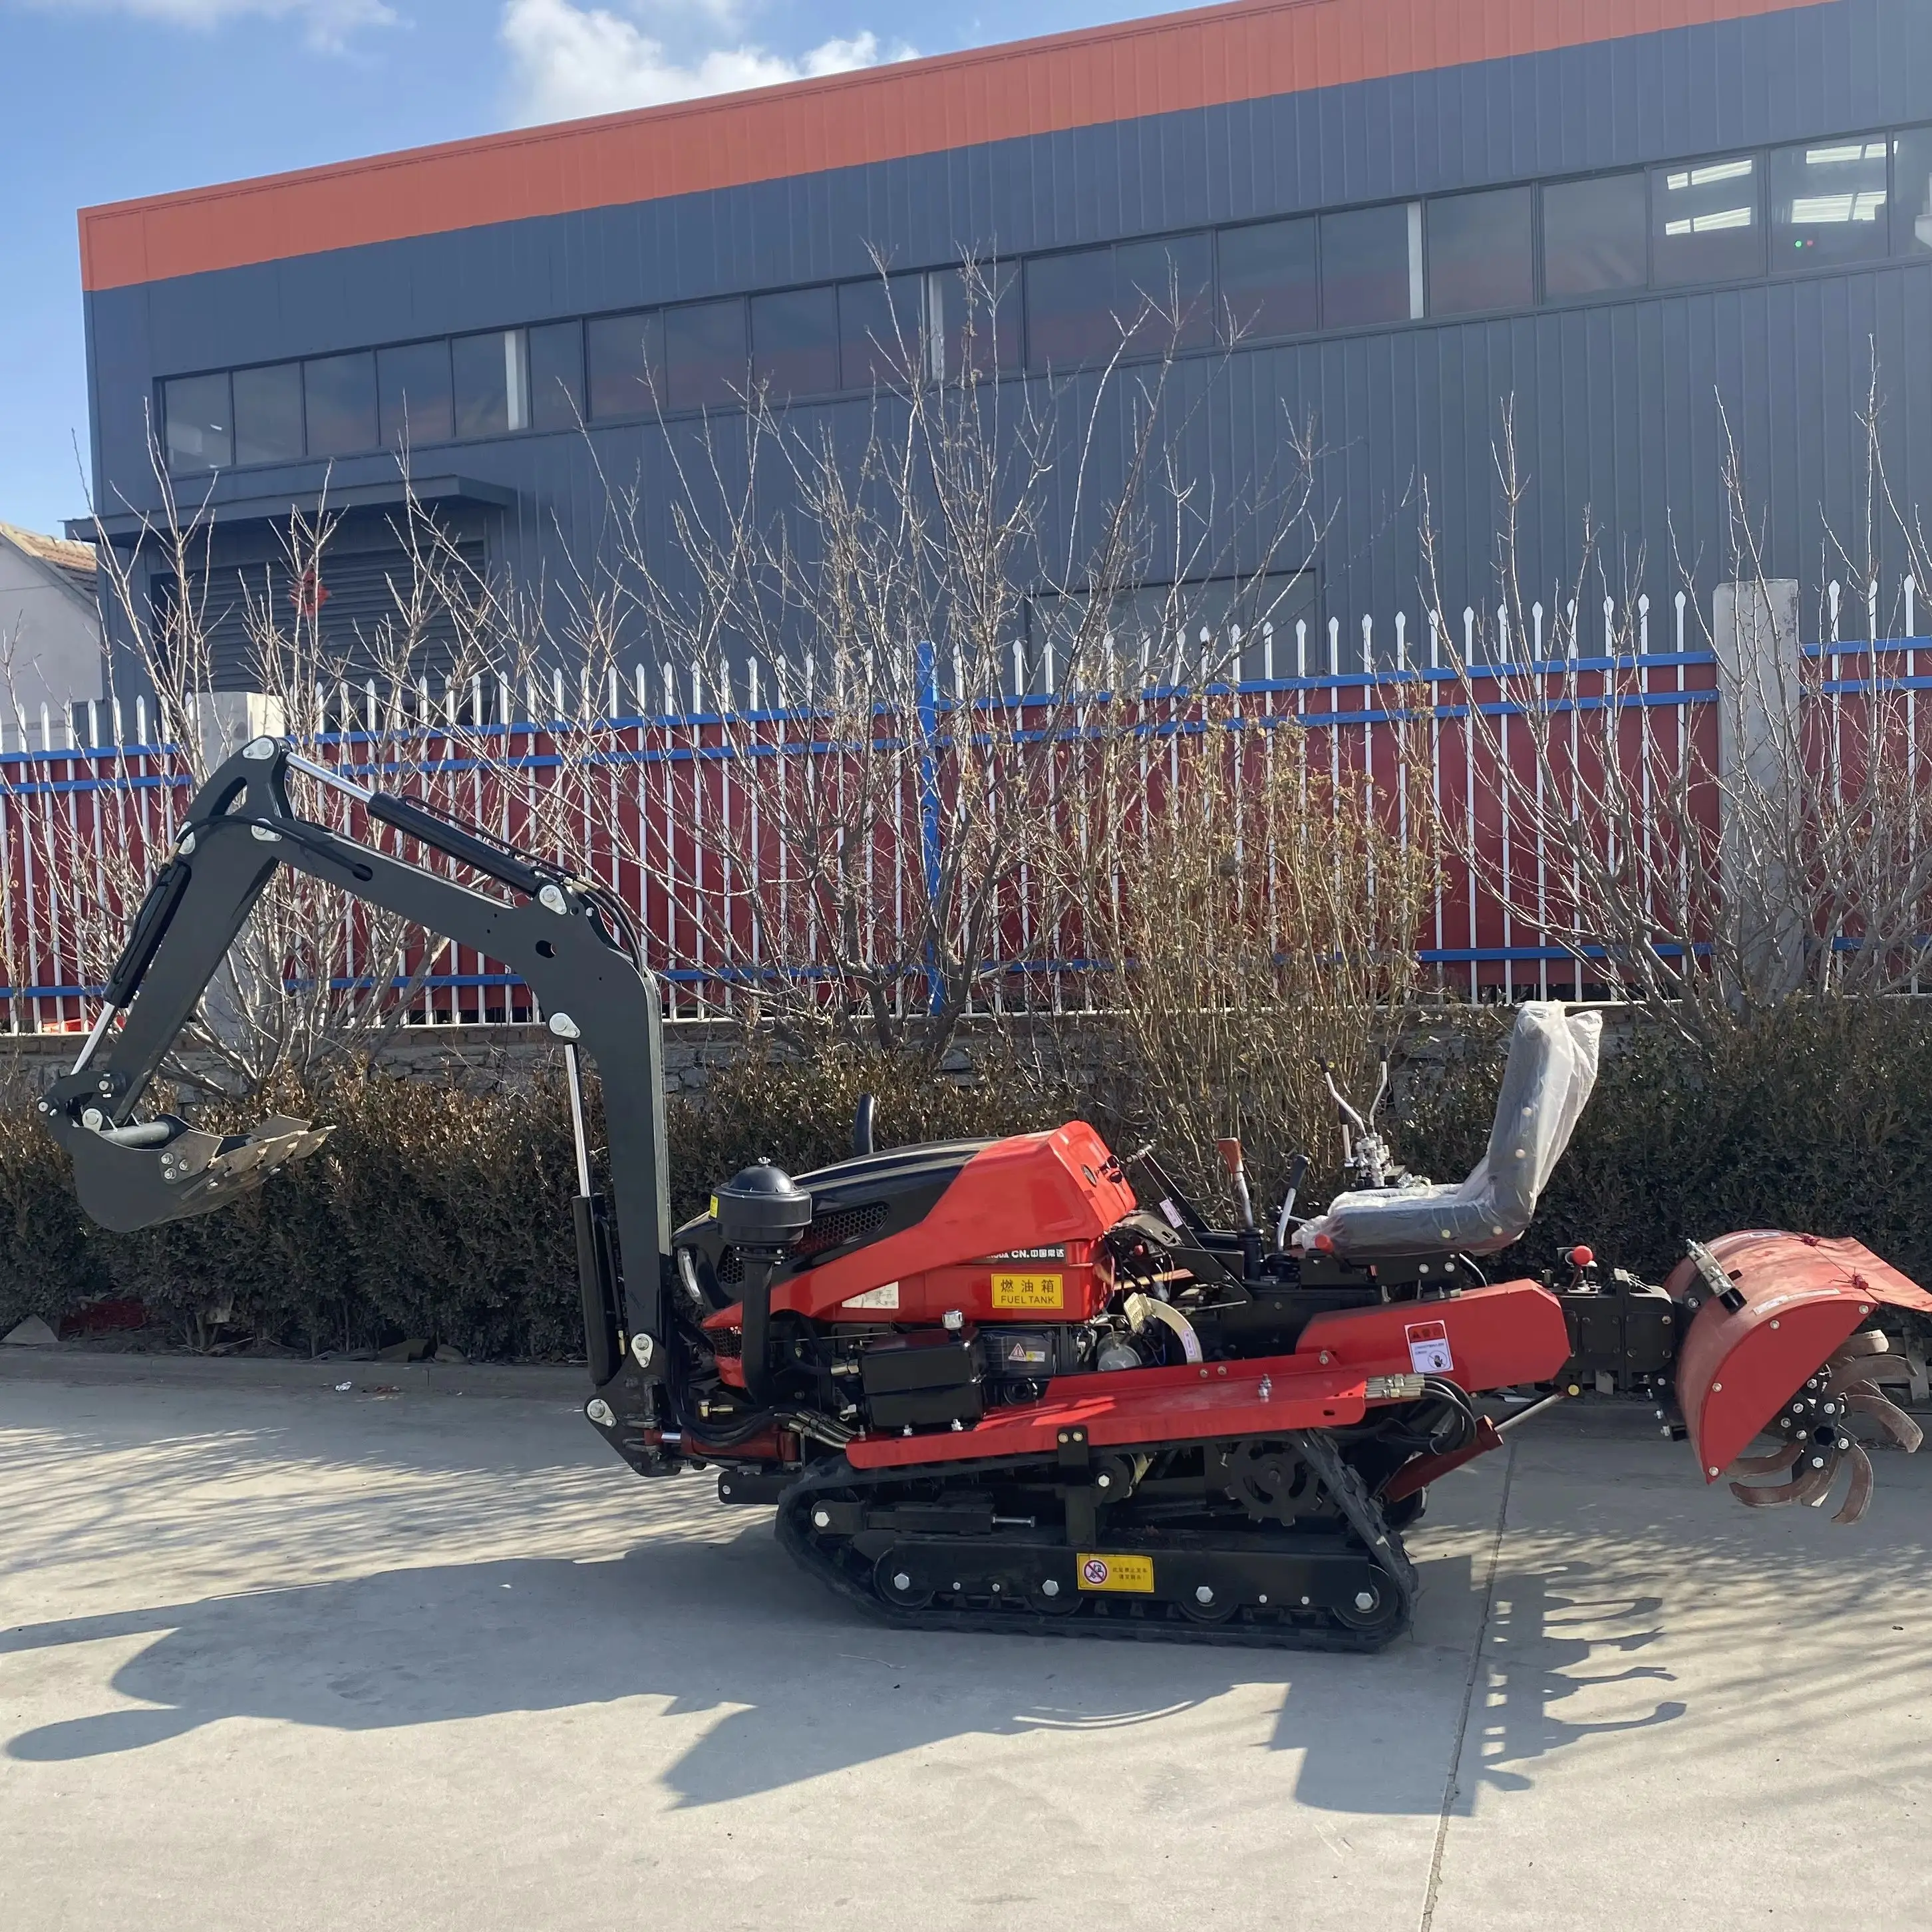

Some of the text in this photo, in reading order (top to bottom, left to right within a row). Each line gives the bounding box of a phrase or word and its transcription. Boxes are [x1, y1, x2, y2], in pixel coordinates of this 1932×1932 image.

[1001, 1279, 1054, 1293] 燃油箱
[1001, 1295, 1054, 1304] FUEL TANK
